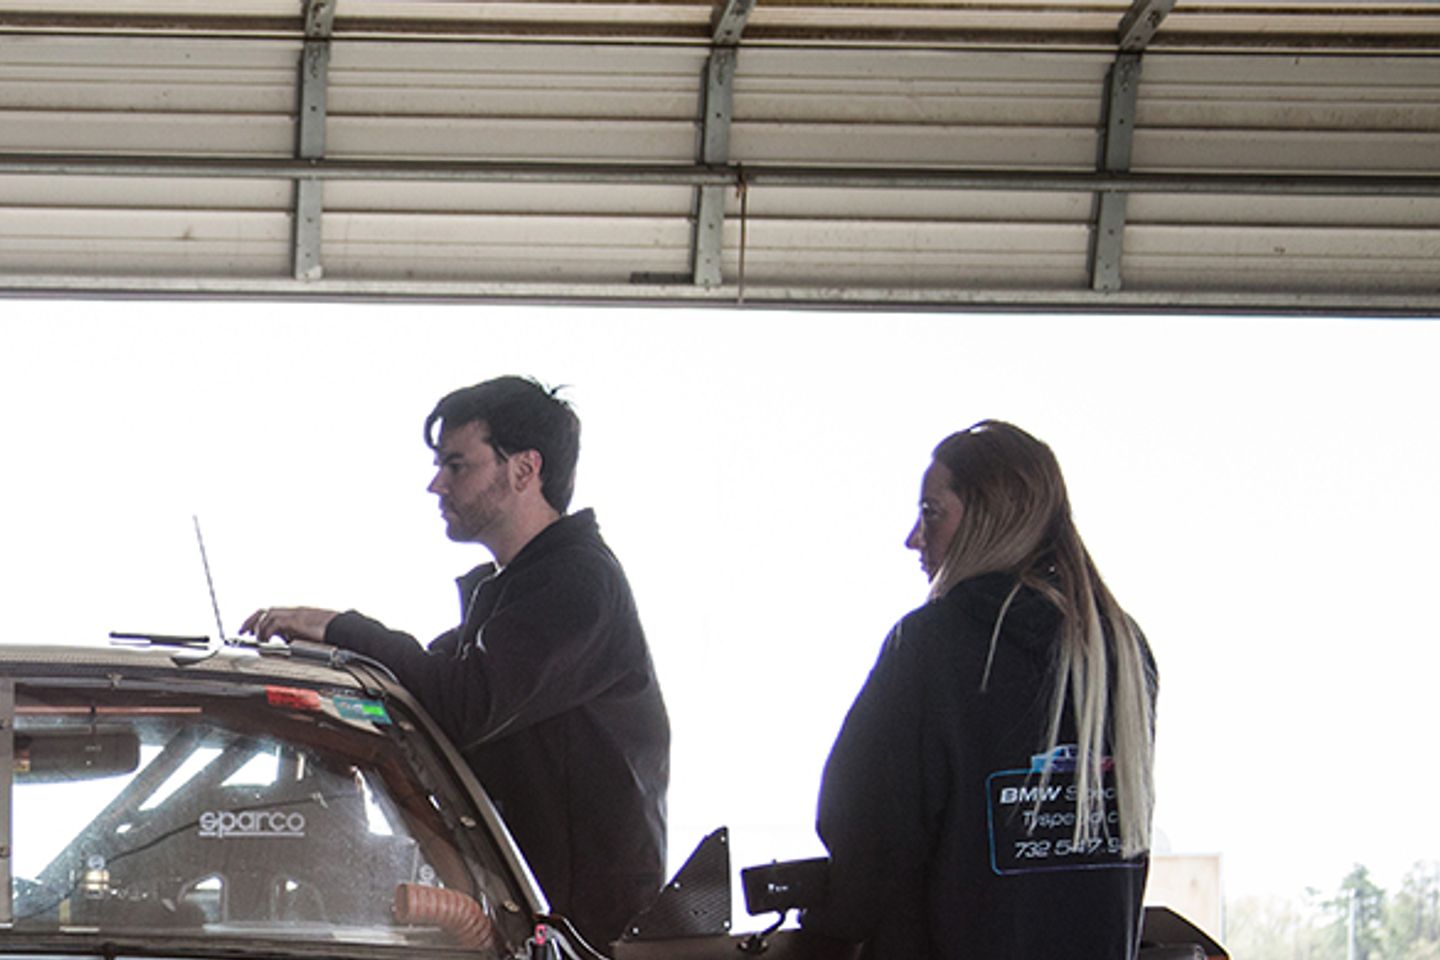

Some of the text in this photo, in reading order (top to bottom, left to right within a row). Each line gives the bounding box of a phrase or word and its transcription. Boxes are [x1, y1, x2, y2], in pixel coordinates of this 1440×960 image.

[999, 786, 1062, 804] BMW
[199, 811, 306, 838] sparco
[1014, 840, 1051, 859] 732
